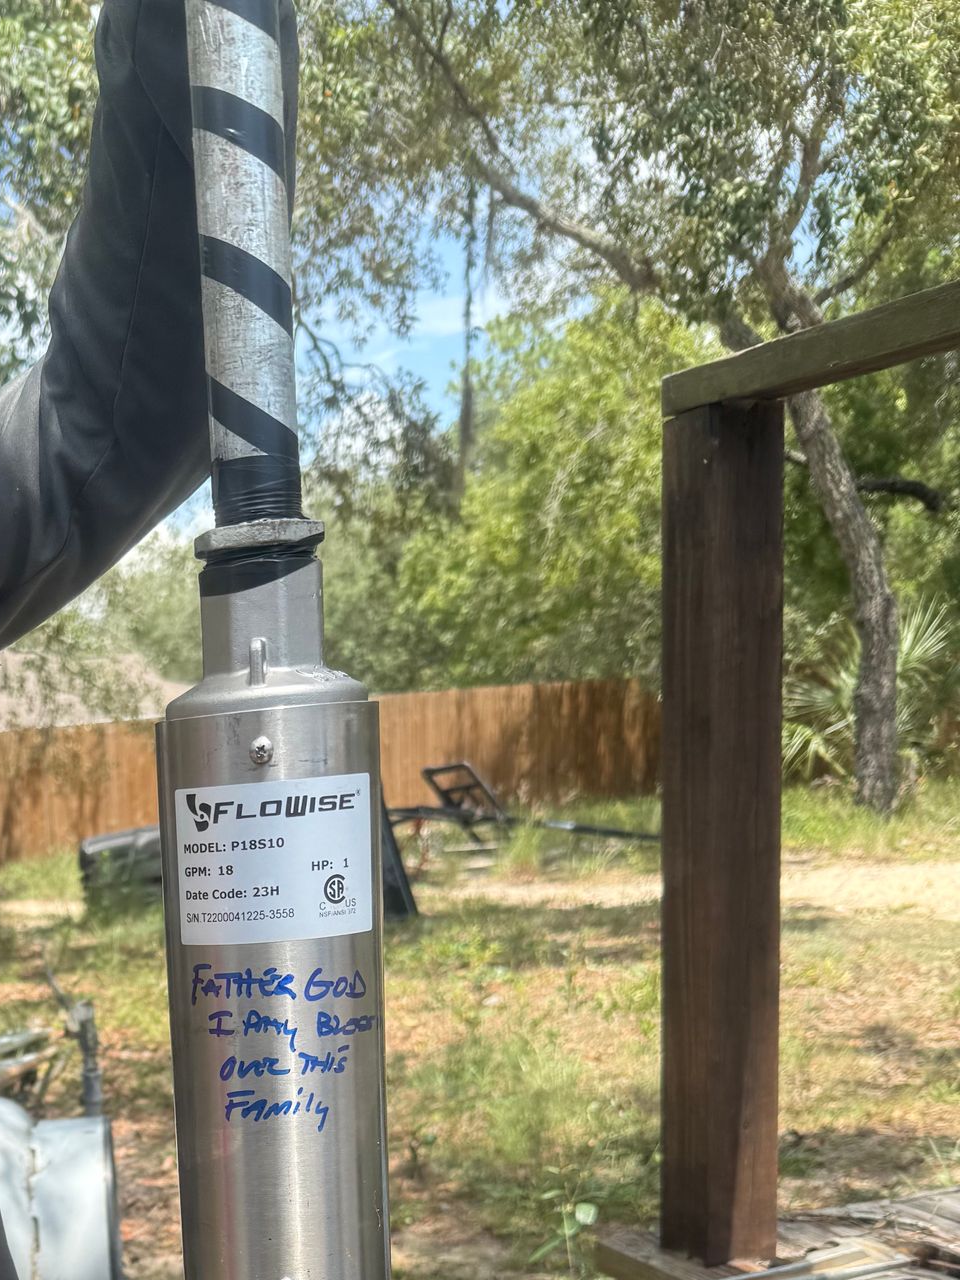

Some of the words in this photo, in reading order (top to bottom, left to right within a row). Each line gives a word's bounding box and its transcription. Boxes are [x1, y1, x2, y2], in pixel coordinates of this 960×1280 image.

[213, 793, 356, 824] FLOWISE
[183, 842, 227, 854] MODEL:
[231, 837, 285, 852] P18S10
[184, 866, 212, 878] GPM:
[218, 865, 234, 876] 18
[311, 860, 333, 871] HP:
[343, 857, 349, 868] 1
[185, 890, 209, 901] Date
[212, 887, 247, 900] Code:
[252, 885, 280, 898] 23H
[344, 897, 357, 908] US
[208, 1010, 236, 1037] I
